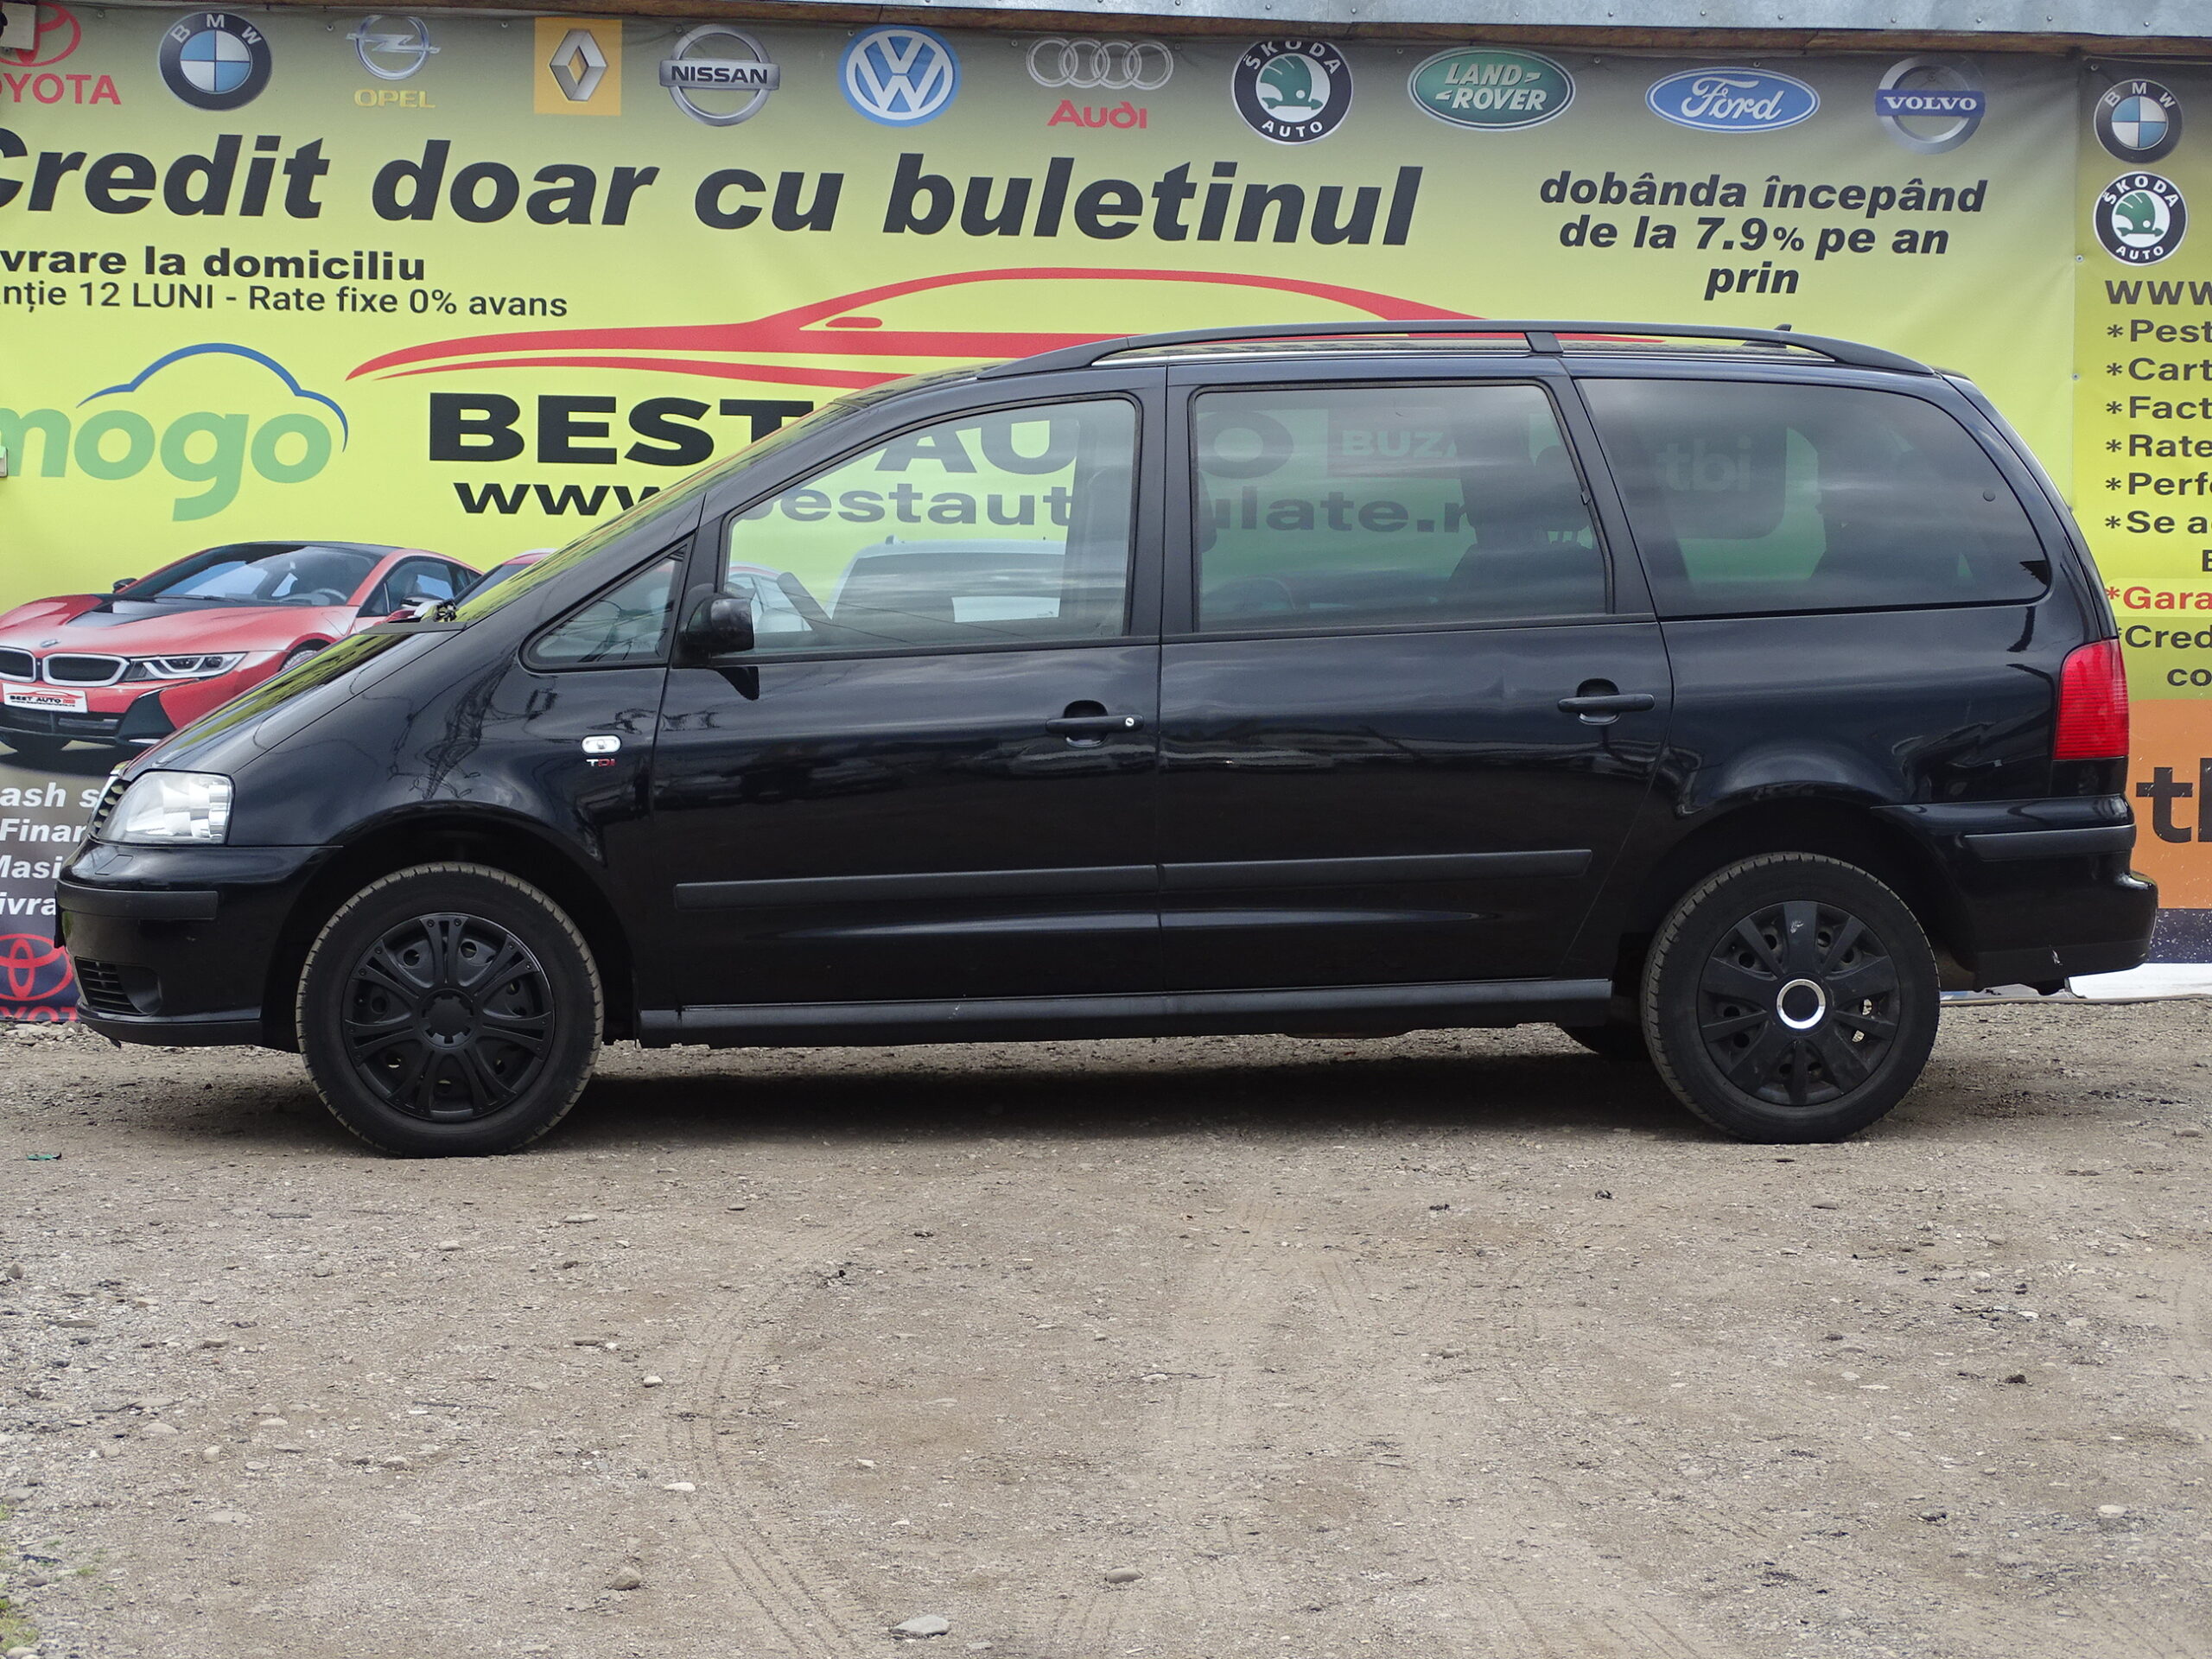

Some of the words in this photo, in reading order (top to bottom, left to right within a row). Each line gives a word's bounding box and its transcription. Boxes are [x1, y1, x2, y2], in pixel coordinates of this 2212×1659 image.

[170, 13, 263, 46] BMW
[0, 73, 122, 105] YOTA
[671, 65, 768, 85] NISSAN
[1444, 63, 1524, 85] LAND
[353, 88, 435, 109] OPEL
[1451, 89, 1549, 111] ROVER
[1681, 77, 1783, 120] Ford
[1884, 94, 1978, 112] VOLVO
[2104, 82, 2176, 109] BMW
[1047, 99, 1147, 129] Audi
[1262, 120, 1323, 138] AUTO
[0, 127, 330, 219] Credit
[372, 139, 660, 226] doar
[694, 168, 844, 232] cu
[882, 152, 1424, 245] buletinul
[1540, 170, 1745, 208] dobânda
[1763, 175, 1988, 219] începând
[1560, 214, 1618, 248] de
[1633, 215, 1677, 249] la
[1696, 217, 1805, 251] 7.9%
[1815, 226, 1876, 260] pe
[1891, 228, 1949, 255] an
[2116, 245, 2164, 260] AUTO
[145, 245, 186, 276] la
[204, 247, 425, 280] domiciliu
[1704, 260, 1800, 301] prin
[79, 282, 121, 307] 12
[133, 283, 213, 309] LUNI
[249, 285, 325, 312] Rate
[336, 286, 397, 313] fixe
[410, 289, 457, 315] 0%
[468, 295, 568, 317] avans
[429, 392, 815, 467] BEST
[1342, 429, 1458, 458] BUZ
[0, 406, 333, 522] mogo
[1656, 435, 1752, 493] tbi
[2117, 624, 2212, 649] Cred
